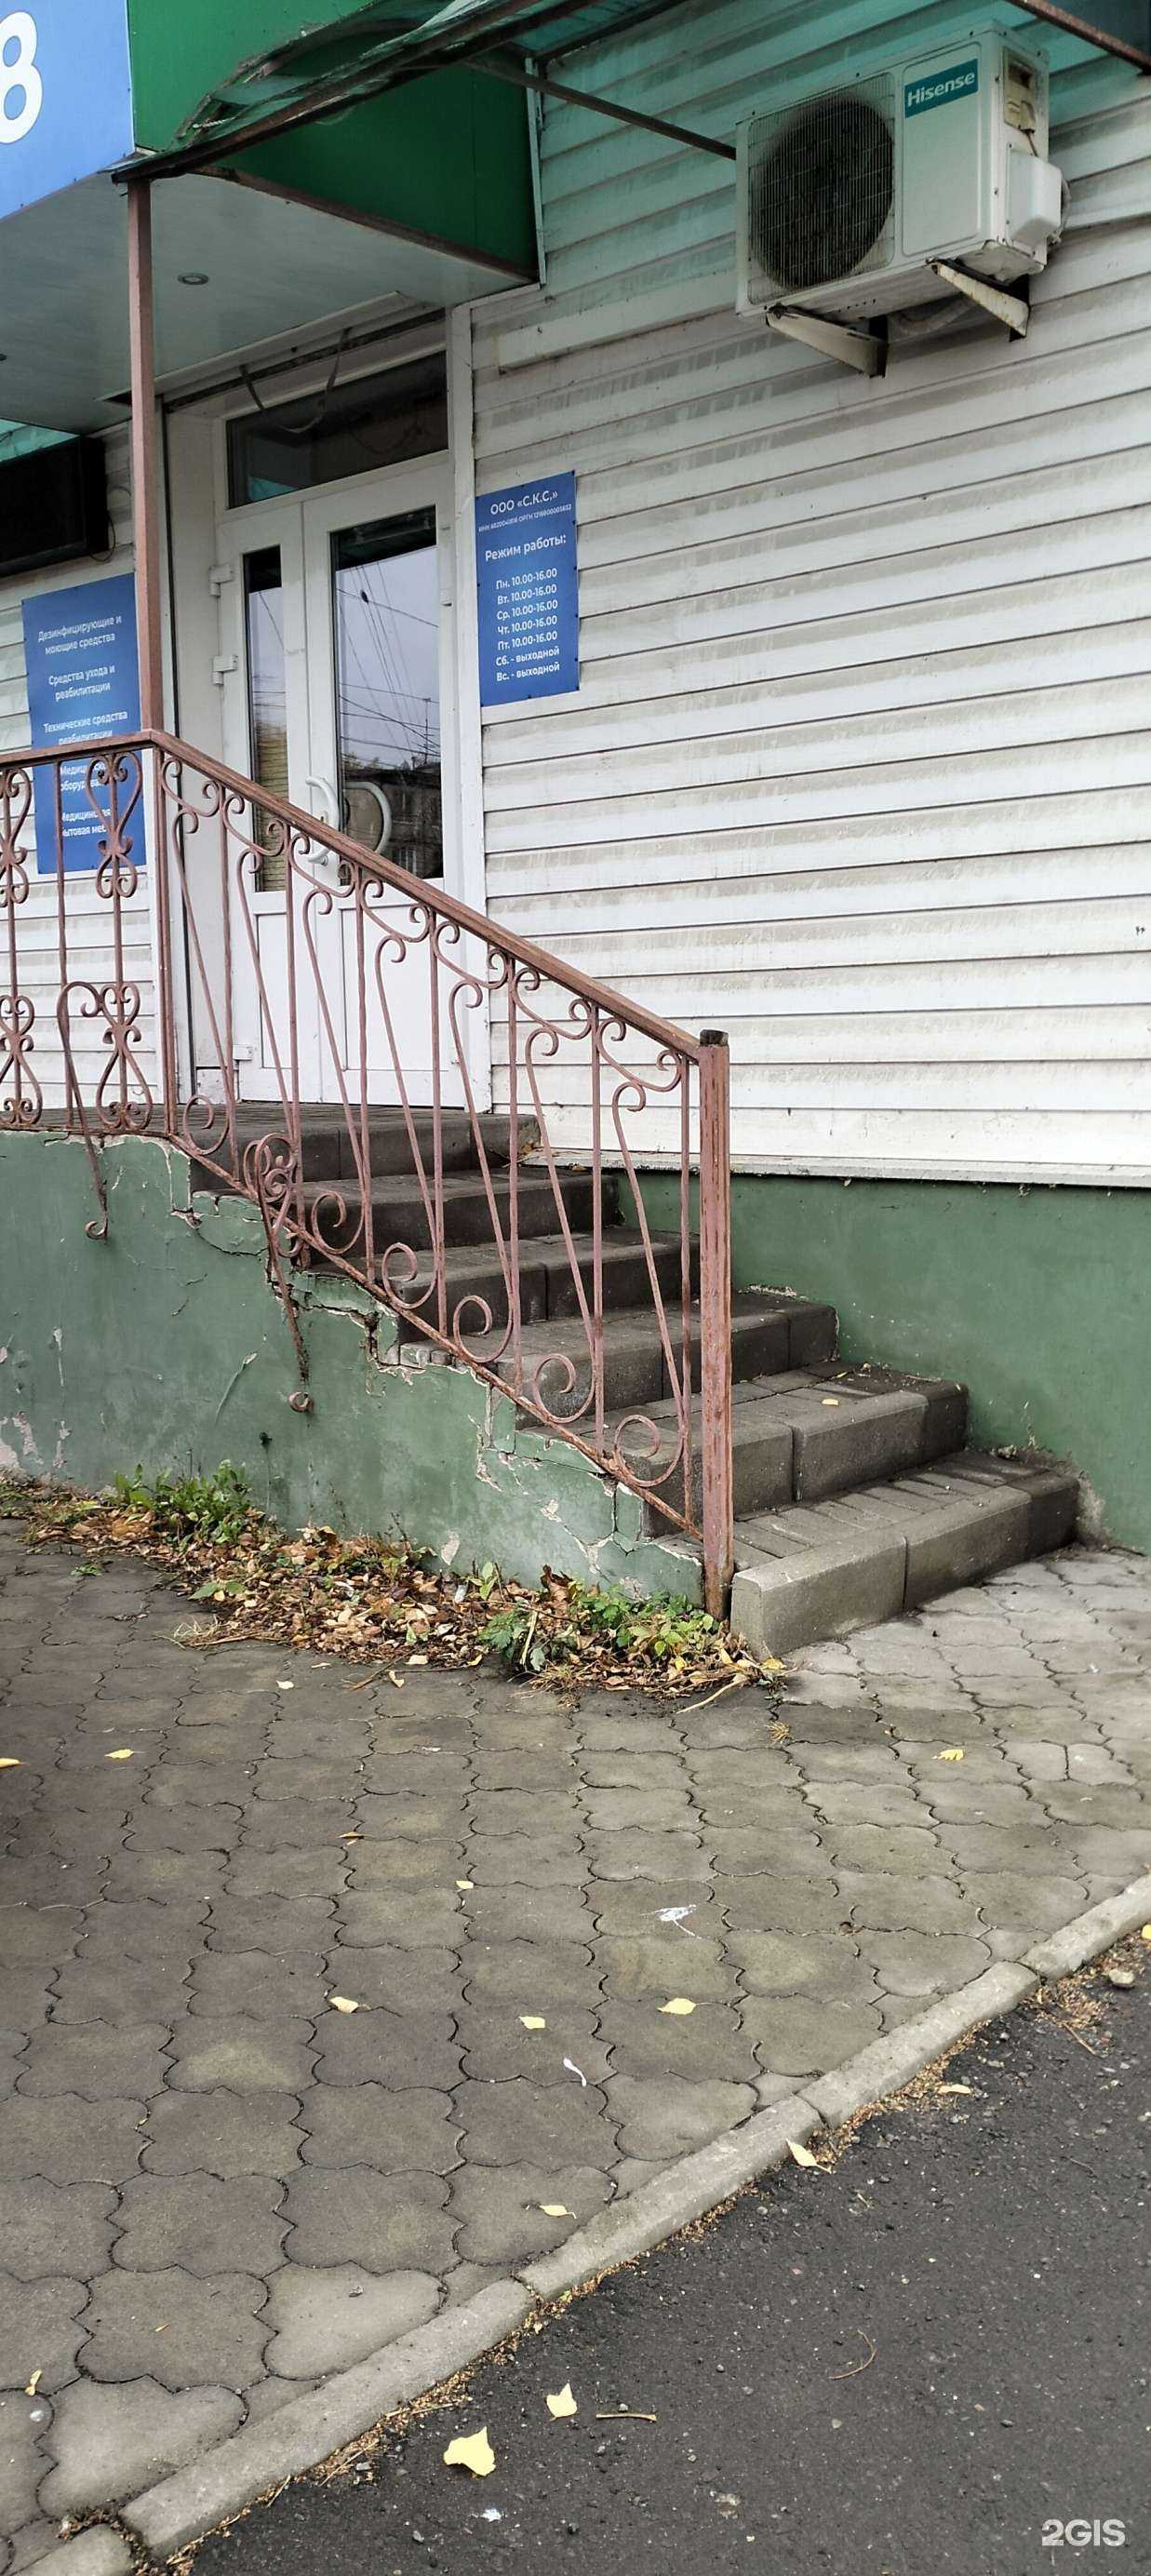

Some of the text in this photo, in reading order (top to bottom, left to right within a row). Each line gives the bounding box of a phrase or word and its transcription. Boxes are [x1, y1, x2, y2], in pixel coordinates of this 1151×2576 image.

[0, 10, 44, 144] 8
[907, 73, 975, 107] Hisense
[490, 490, 558, 515] ООО «С.К.С.»
[485, 534, 567, 562] Режим работы:
[496, 568, 557, 589] Пн. 10.00-16.00
[497, 584, 557, 604] Вт. 10.00-16.00
[497, 599, 558, 621] Ср. 10.00-16.00
[38, 615, 123, 642] Дезинфицирующие и
[498, 615, 557, 635] Чт. 10.00-16.00
[45, 634, 115, 654] моющие средства
[498, 631, 557, 651] Пт. 10.00-16.00
[496, 655, 509, 666] Сб.
[515, 646, 560, 663] выходной
[48, 665, 115, 687] Средства ухода и
[496, 673, 510, 681] Вс.
[516, 662, 560, 678] выходной
[55, 682, 111, 702] реабилитации
[43, 711, 127, 733] Технические средства
